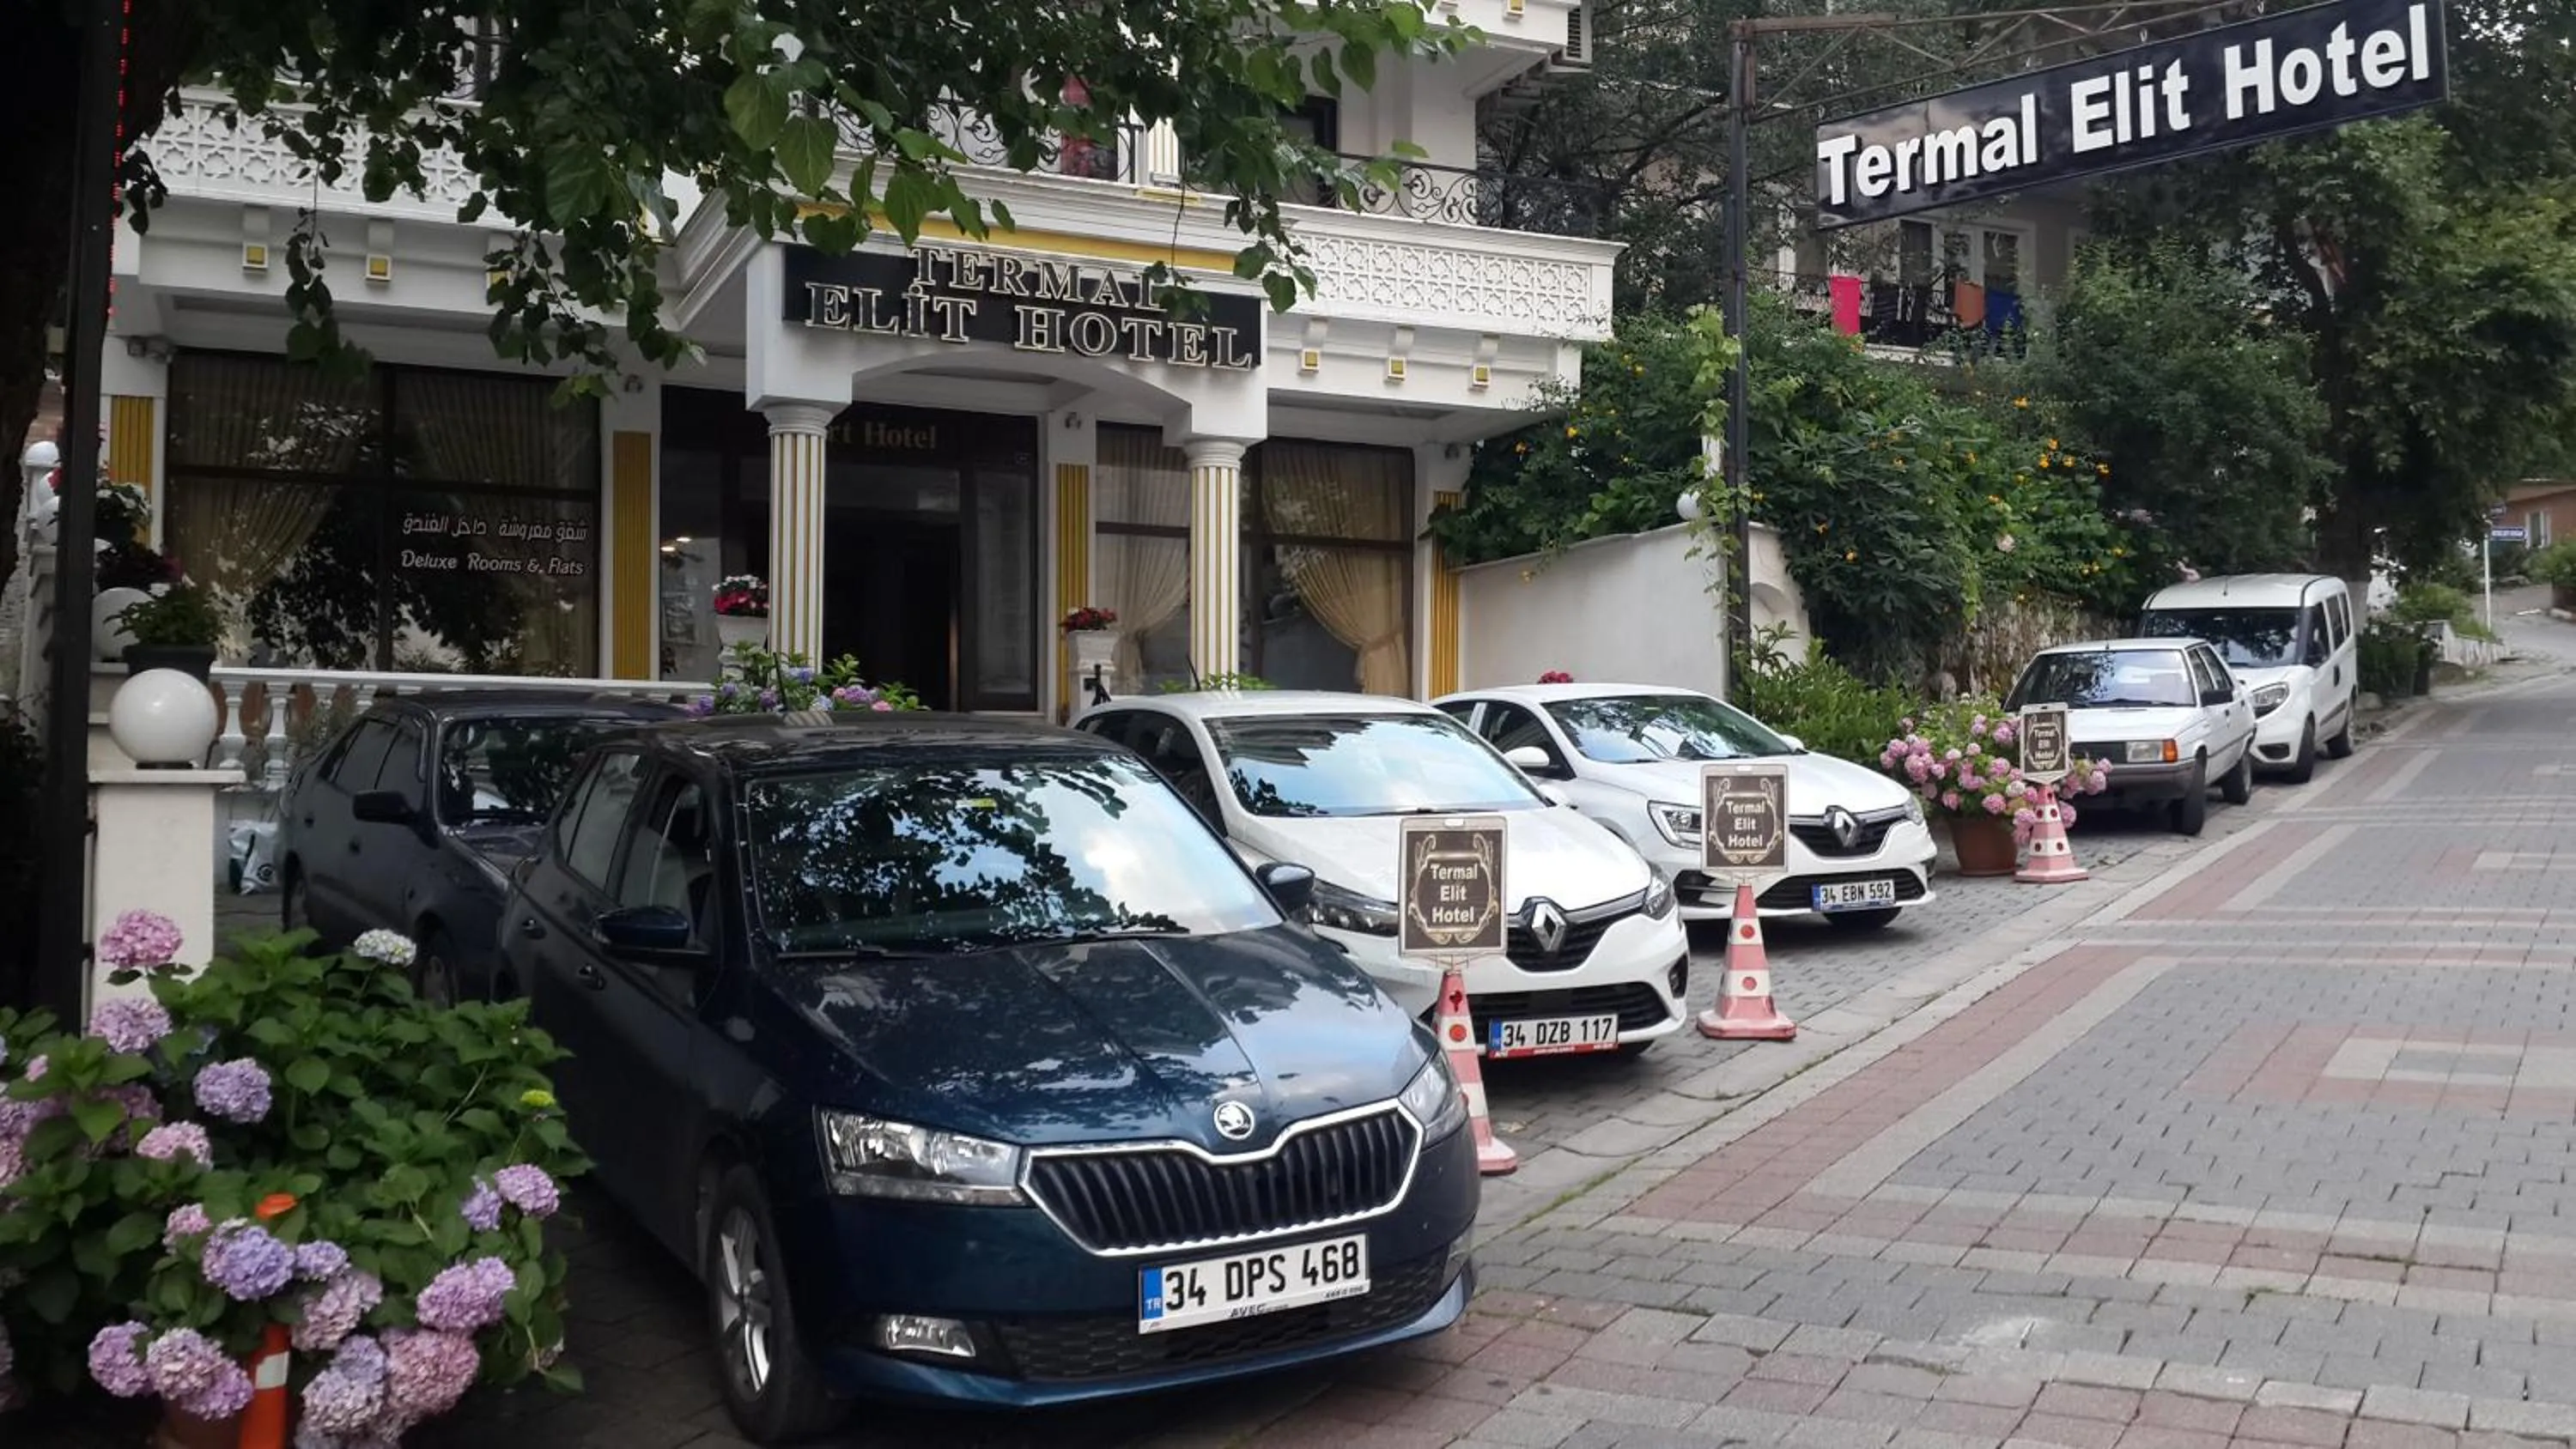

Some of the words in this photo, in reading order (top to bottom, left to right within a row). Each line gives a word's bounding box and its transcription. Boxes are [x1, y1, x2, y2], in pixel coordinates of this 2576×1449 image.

[1817, 94, 2038, 206] Termal
[2070, 58, 2190, 155] Elit
[2224, 3, 2429, 120] Hotel
[1014, 305, 1253, 371] HOTEL
[865, 421, 936, 449] Hotel
[400, 549, 458, 569] Deluxe
[467, 552, 521, 573] Rooms
[548, 557, 584, 575] Flats
[1726, 799, 1766, 815] Termal
[1734, 818, 1756, 831] Elit
[1728, 835, 1764, 848] Hotel
[1430, 863, 1479, 881] Termal
[1439, 885, 1467, 901] Elit
[1821, 887, 1837, 904] 34
[1869, 882, 1892, 899] 592
[1431, 906, 1475, 924] Hotel
[1504, 1023, 1526, 1046] 34
[1536, 1021, 1571, 1045] DZB
[1581, 1018, 1613, 1041] 117
[1164, 1268, 1206, 1312] 34
[1225, 1254, 1286, 1301] DPS
[1301, 1240, 1359, 1287] 468
